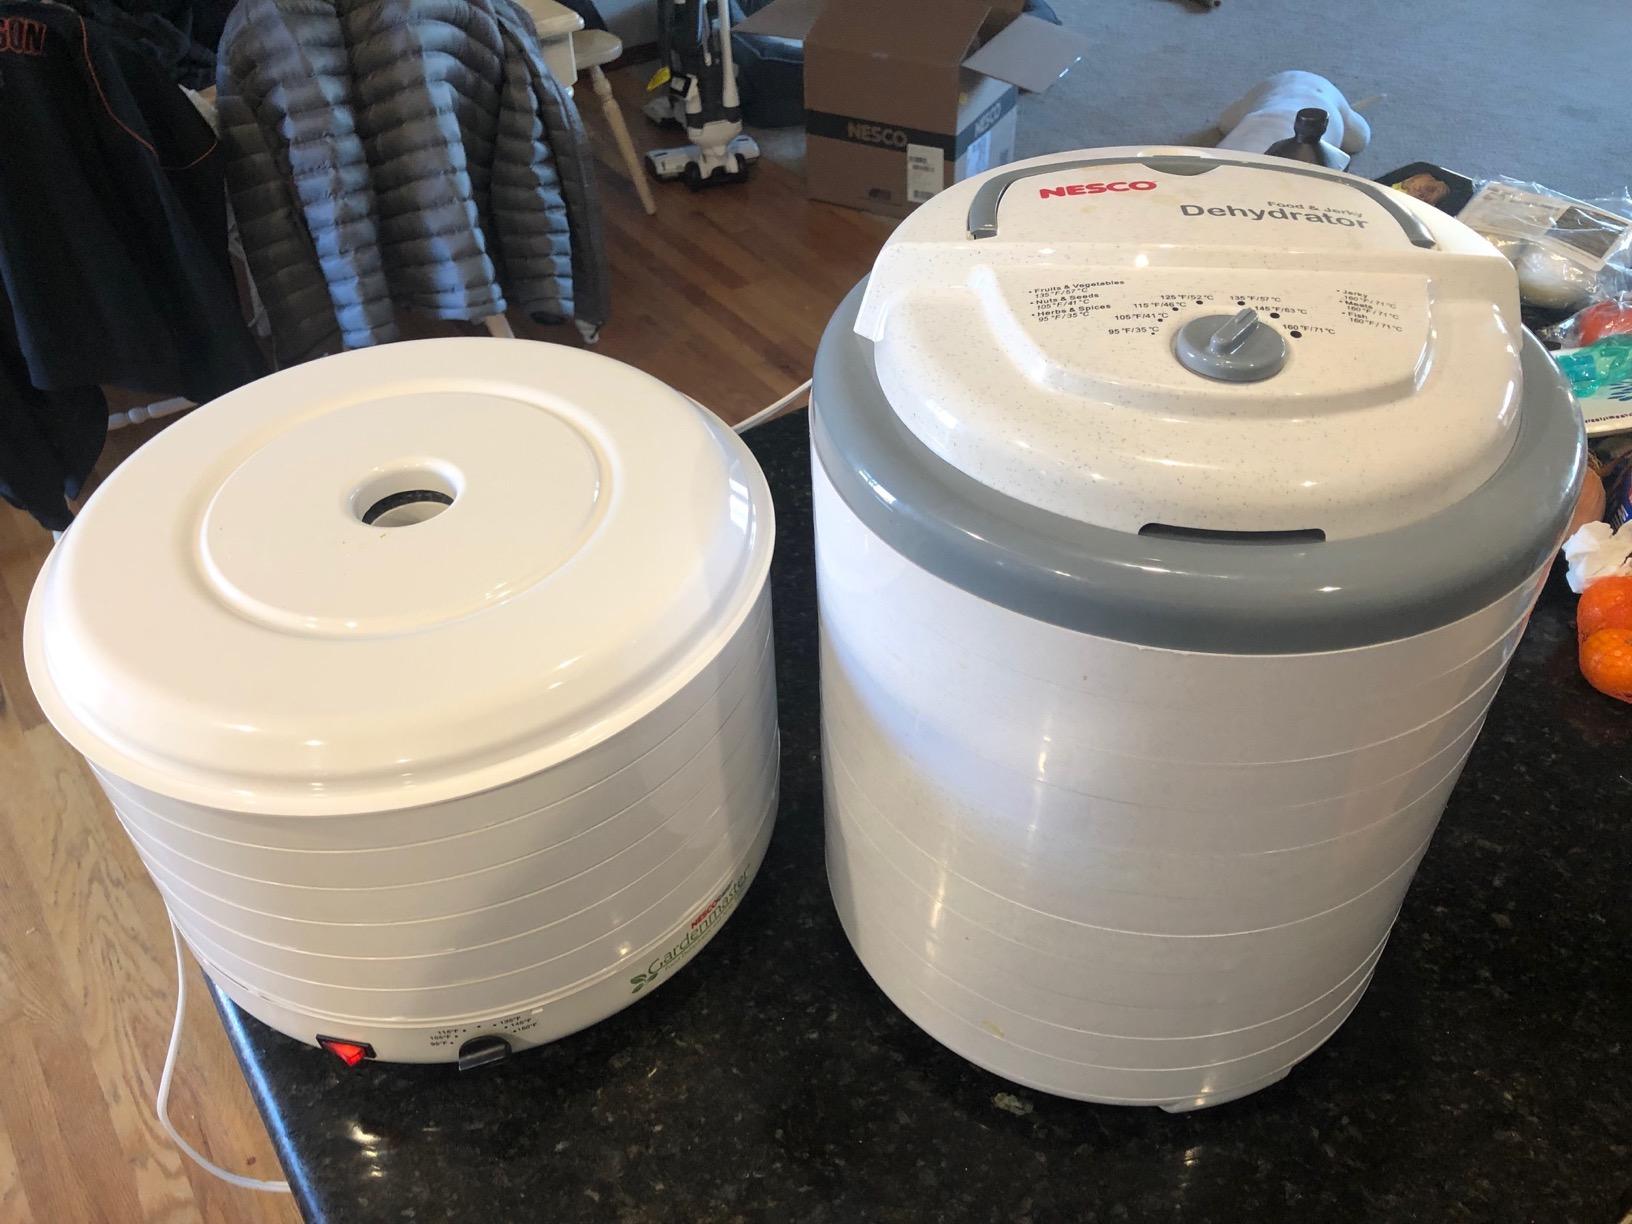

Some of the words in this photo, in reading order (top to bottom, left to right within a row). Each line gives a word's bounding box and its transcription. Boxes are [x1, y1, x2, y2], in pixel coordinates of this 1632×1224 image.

[847, 122, 908, 147] NESCO
[1039, 180, 1157, 199] NESCO
[1179, 204, 1369, 230] Dehydrator
[1267, 201, 1305, 209] Food
[1324, 207, 1363, 218] Jerky
[1034, 286, 1062, 294] Fruits
[1072, 280, 1125, 289] Vegetables
[1037, 309, 1067, 317] Herbs
[1078, 304, 1111, 312] Spices
[648, 863, 751, 975] Gardenmaster
